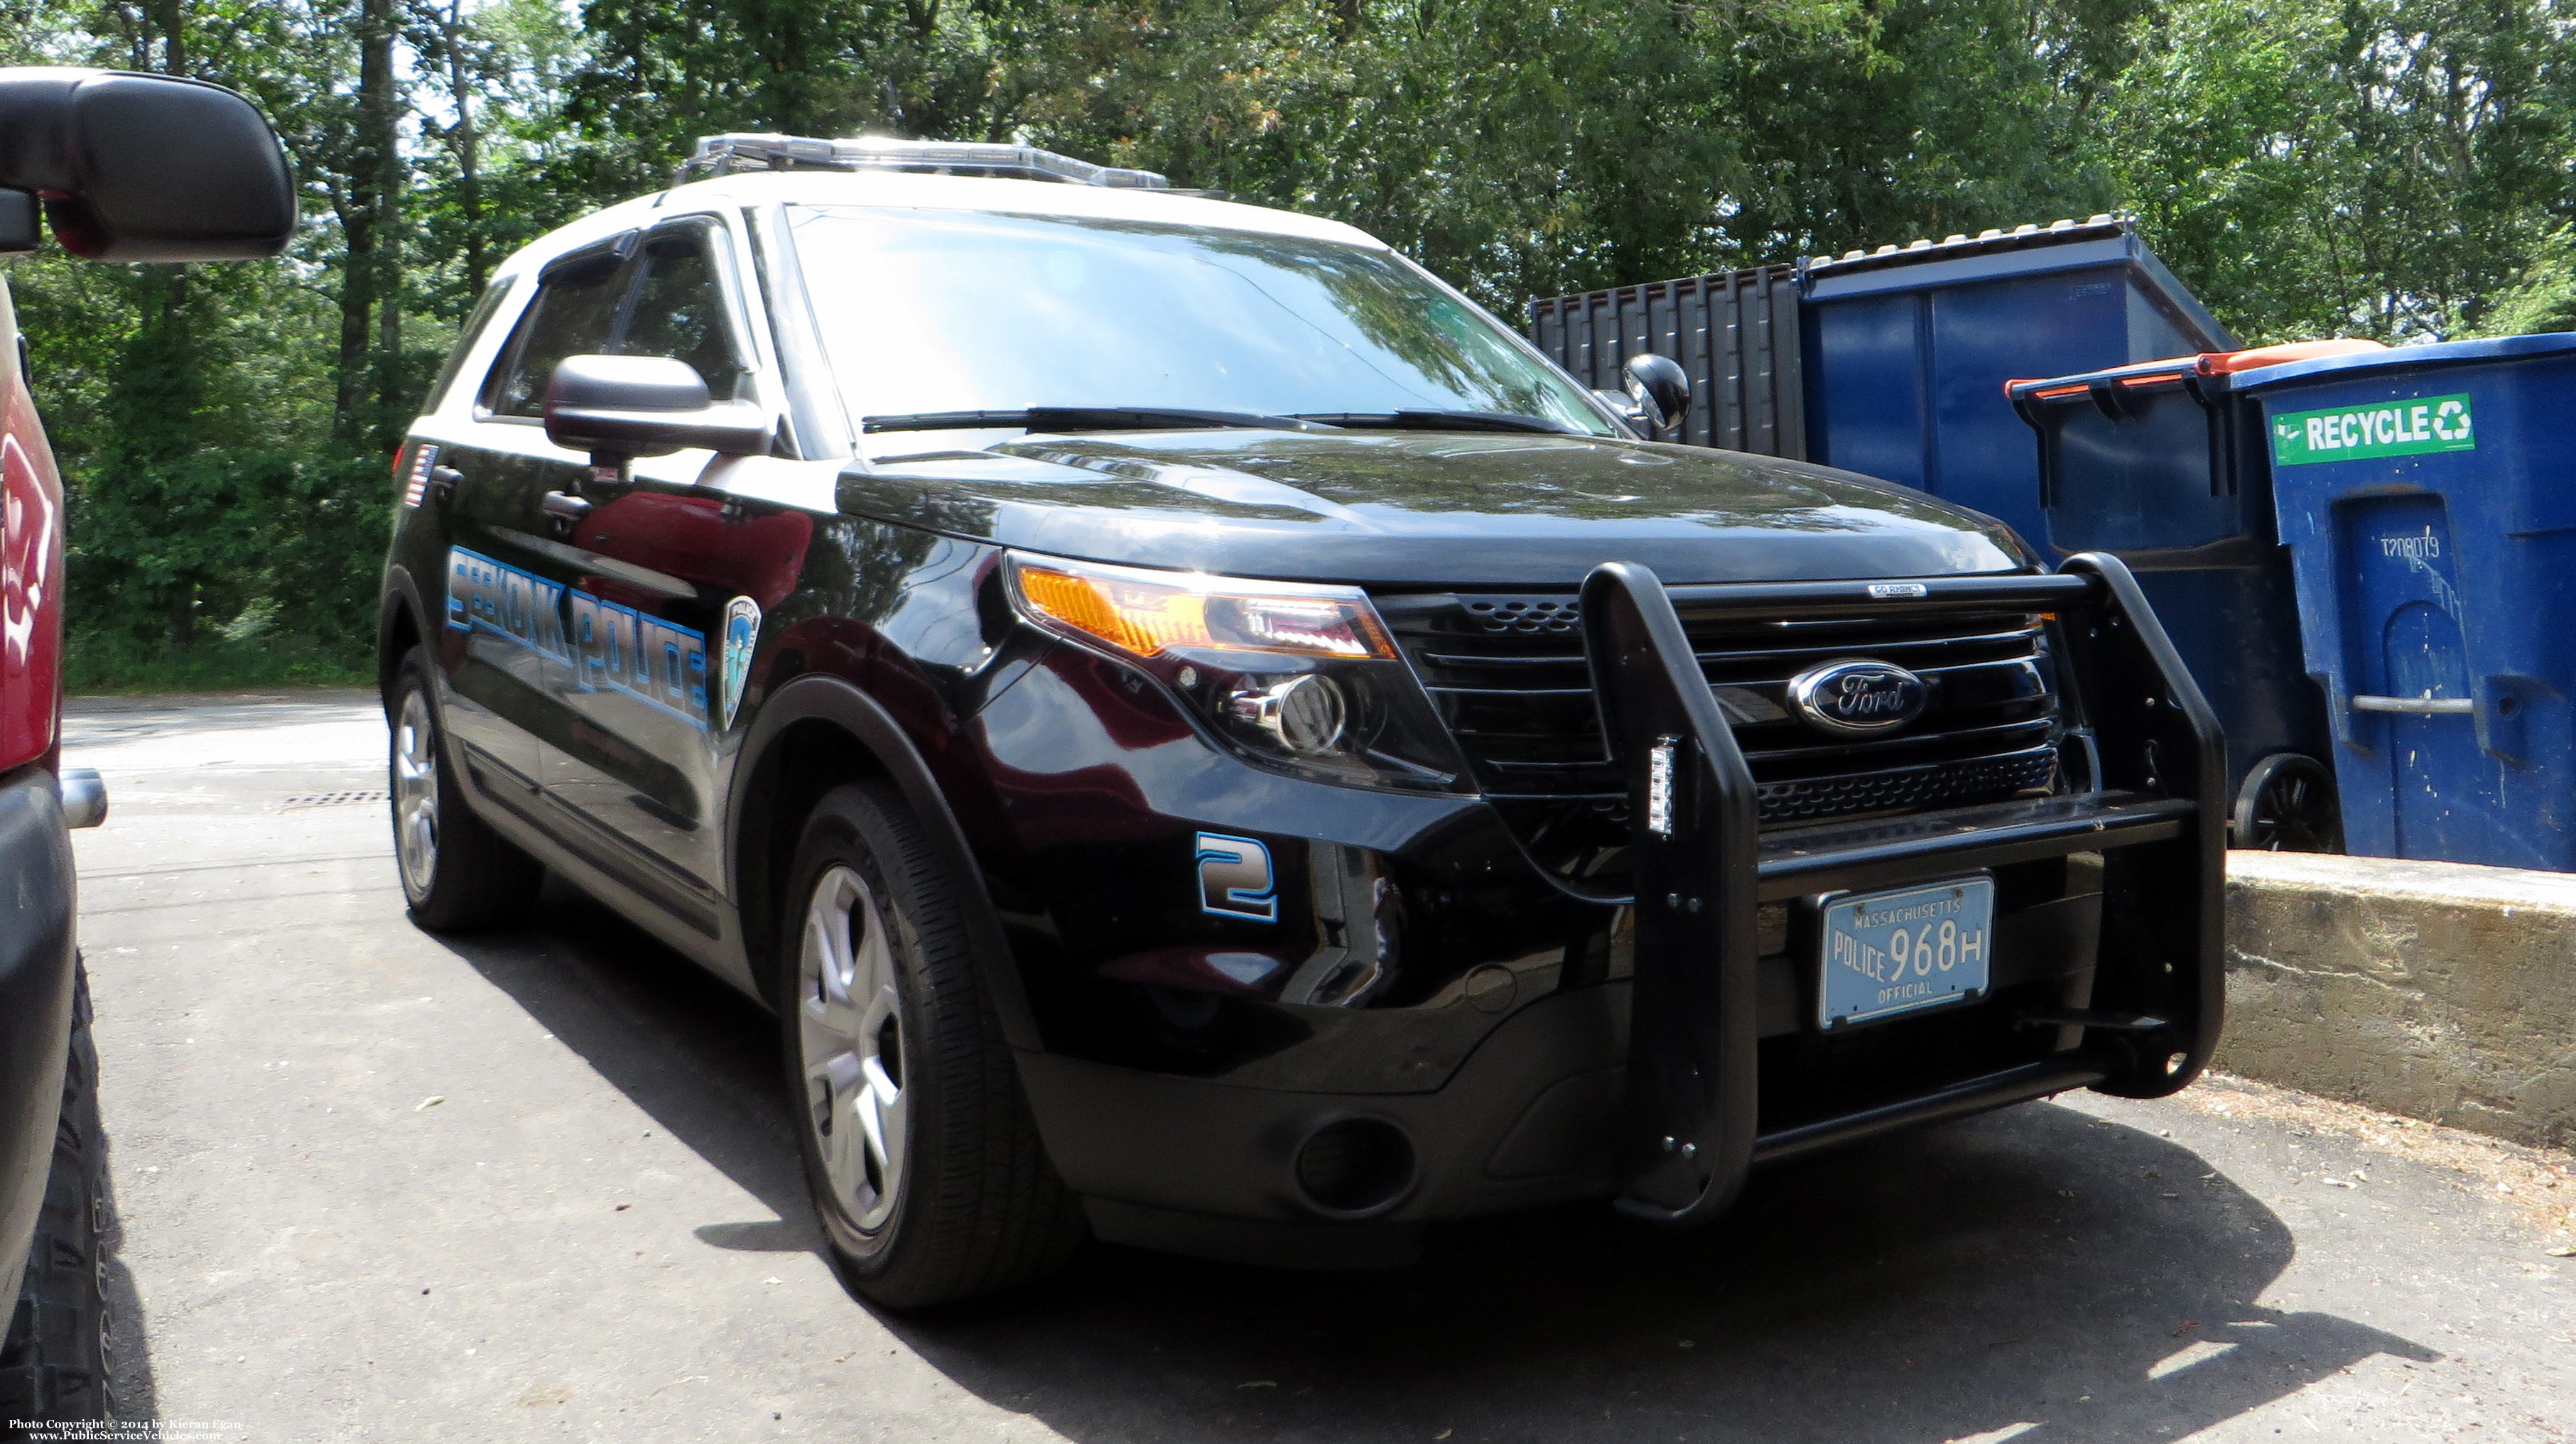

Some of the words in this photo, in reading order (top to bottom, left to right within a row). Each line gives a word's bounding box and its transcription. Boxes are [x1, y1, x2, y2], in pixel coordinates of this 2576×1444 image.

[2306, 405, 2430, 451] RECYCLE
[569, 587, 708, 732] POLICE
[1838, 673, 1905, 715] Ford
[1195, 830, 1278, 923] 2
[1854, 899, 1961, 930] MASSACHUSETTS
[1834, 929, 1886, 983] POLICE
[1878, 980, 1933, 1005] OFFICIAL
